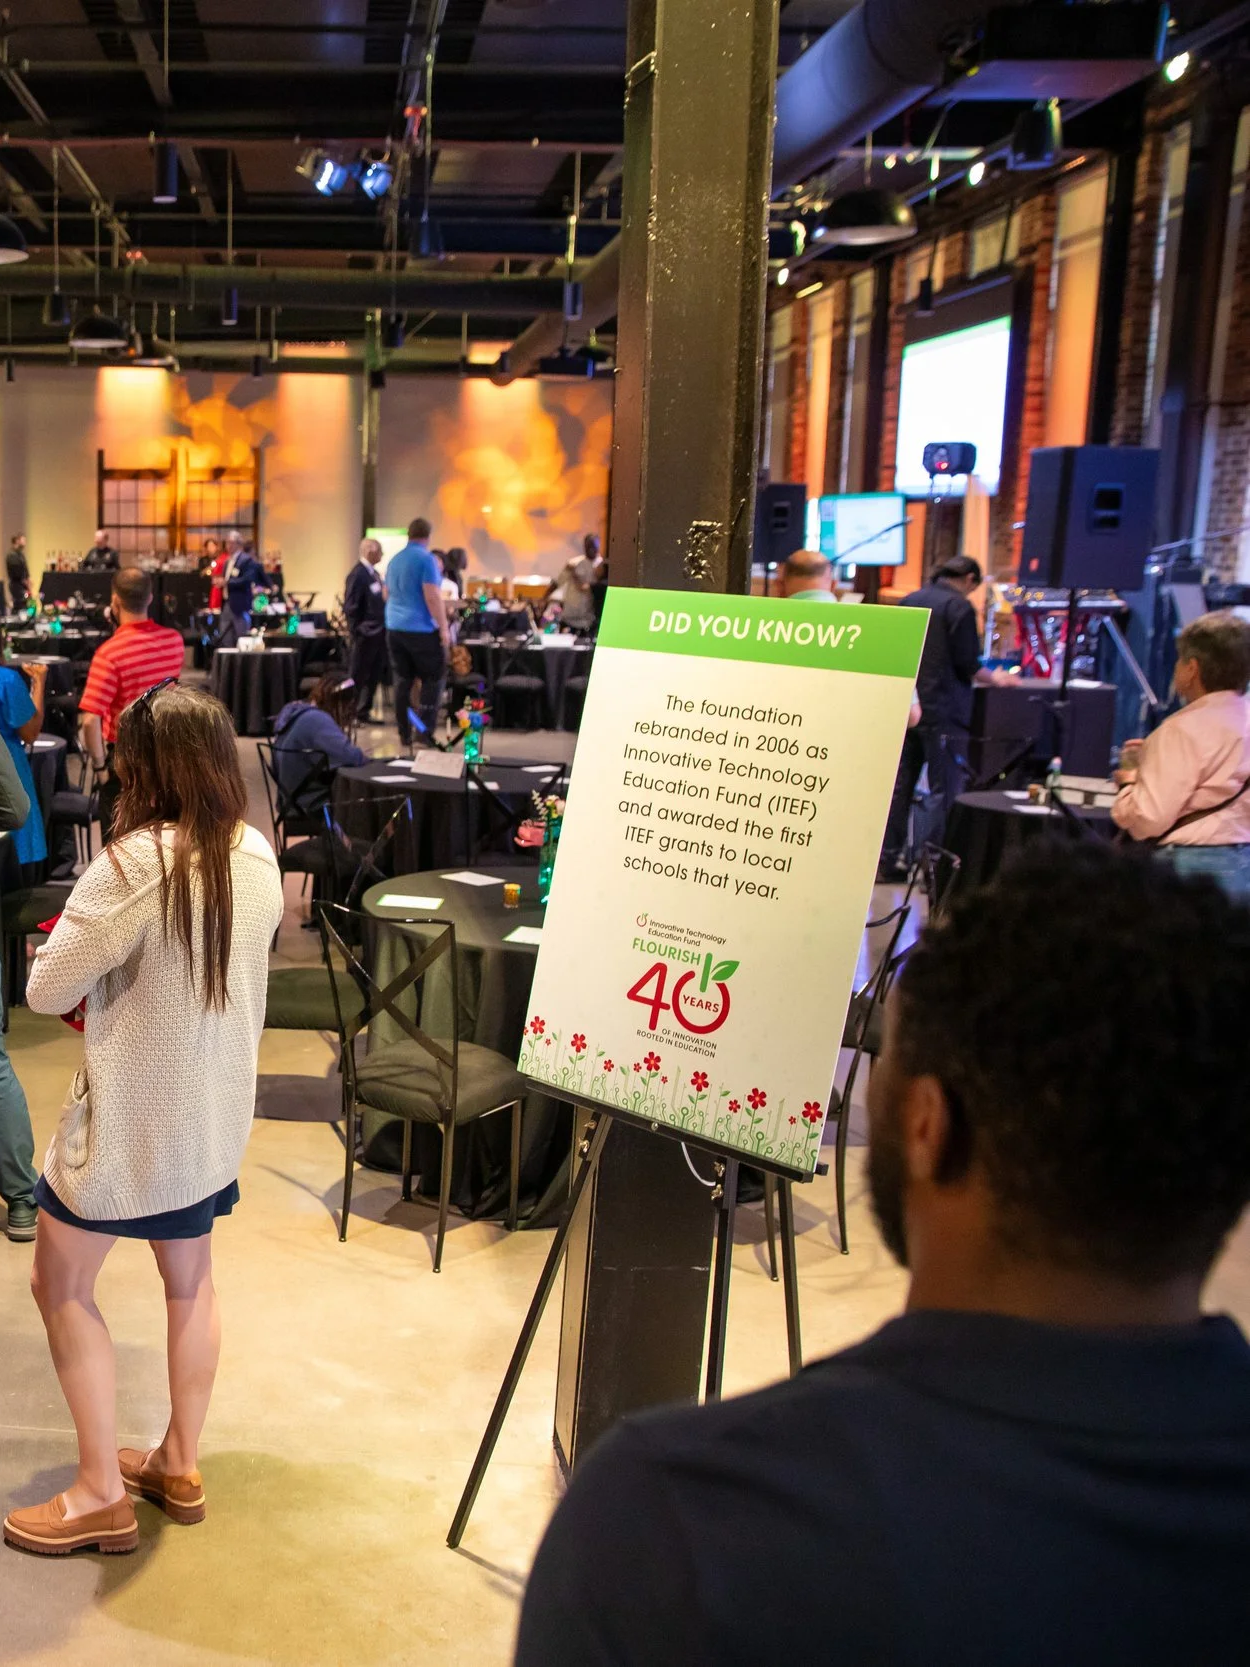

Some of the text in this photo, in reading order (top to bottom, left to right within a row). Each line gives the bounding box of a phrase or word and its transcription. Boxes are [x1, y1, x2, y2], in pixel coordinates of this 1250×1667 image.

[649, 610, 862, 650] DID YOU KNOW?
[665, 695, 803, 728] The foundation
[633, 719, 829, 760] rebranded in 2006 as
[623, 744, 830, 794] Innovative Technology
[623, 770, 817, 823] Education Fund (ITEF)
[618, 800, 813, 847] and awarded the first
[624, 825, 792, 873] ITEF grants to local
[623, 855, 780, 901] schools that year.
[632, 937, 701, 966] FLOURISH
[648, 928, 701, 947] Education Fund
[650, 919, 727, 945] Innovative Technology
[627, 962, 730, 1034] 40
[682, 994, 720, 1013] YEARS
[636, 1029, 716, 1058] ROOTED IN EDUCATION
[662, 1028, 717, 1050] OF INNOVATION
